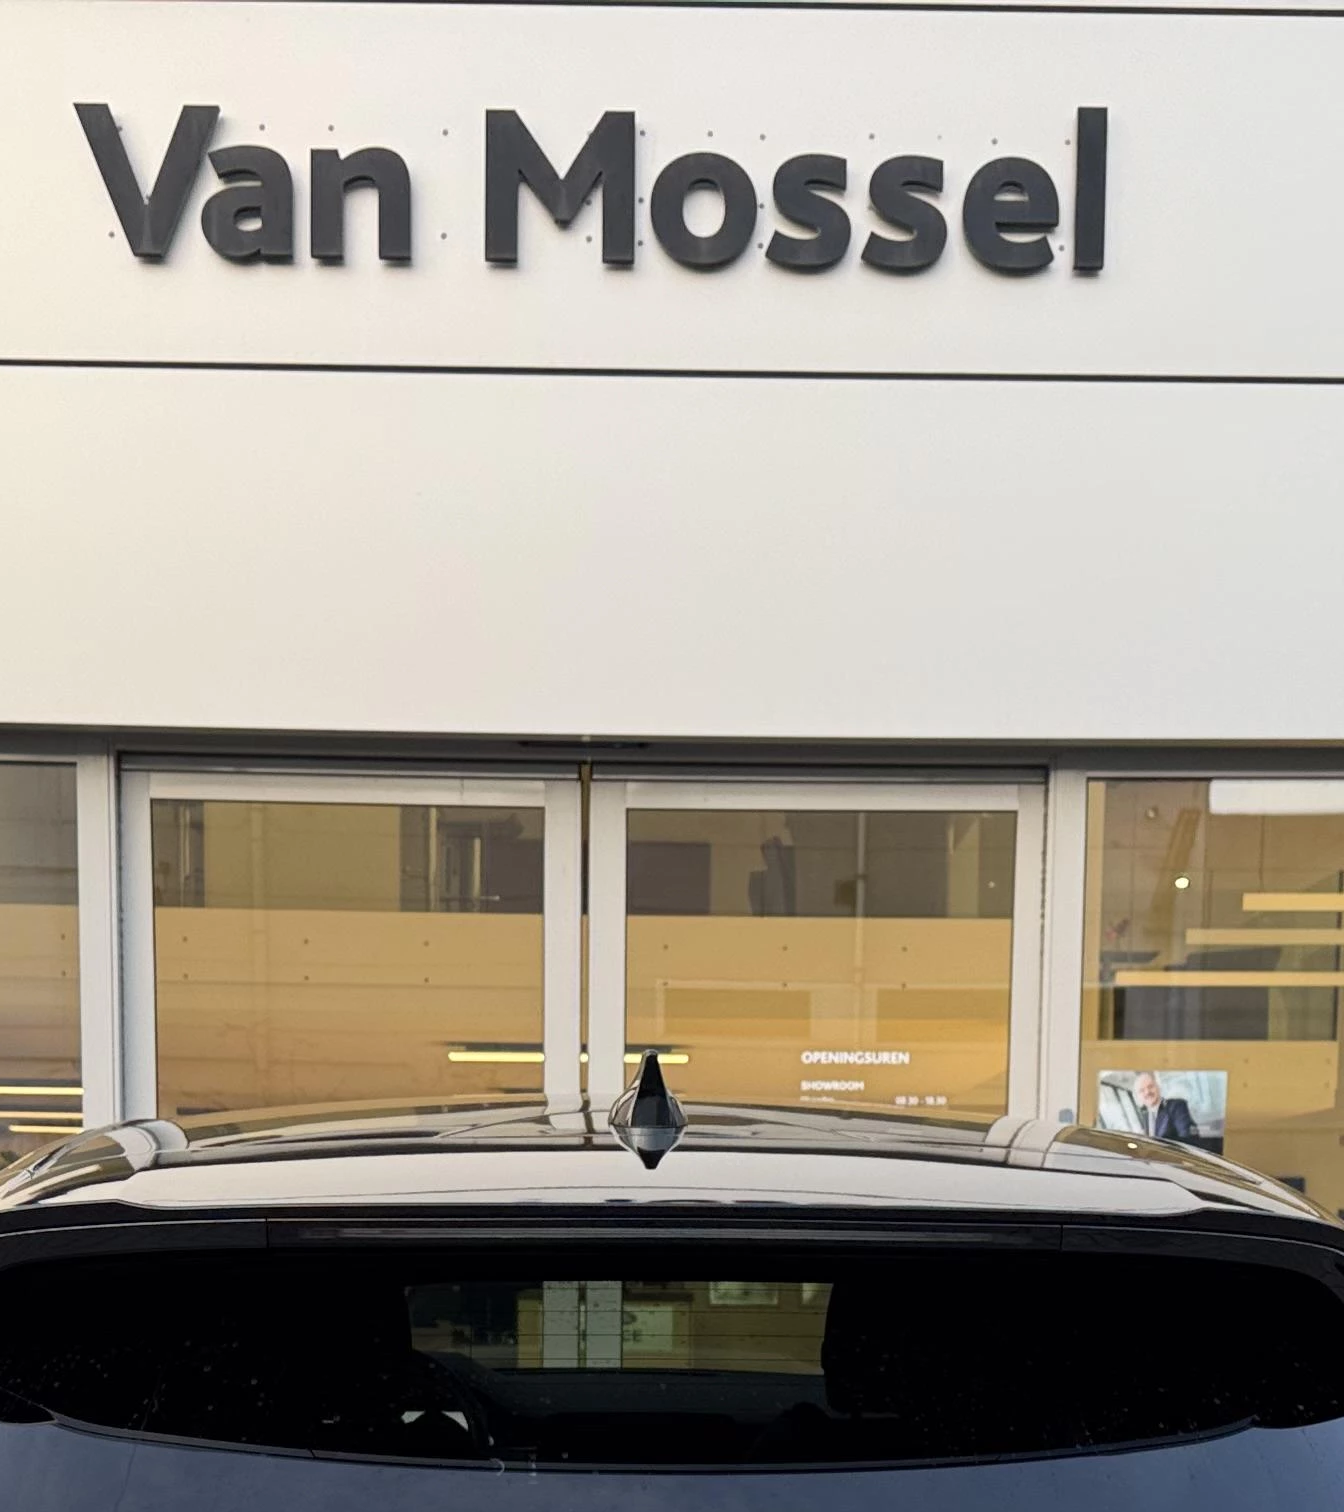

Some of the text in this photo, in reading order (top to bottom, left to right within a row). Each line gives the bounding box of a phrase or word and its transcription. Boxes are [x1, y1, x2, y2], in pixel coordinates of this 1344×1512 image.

[73, 102, 1108, 275] Van Mossel
[800, 1051, 911, 1065] OPENINGSUREN
[800, 1080, 865, 1091] SHOWROOM
